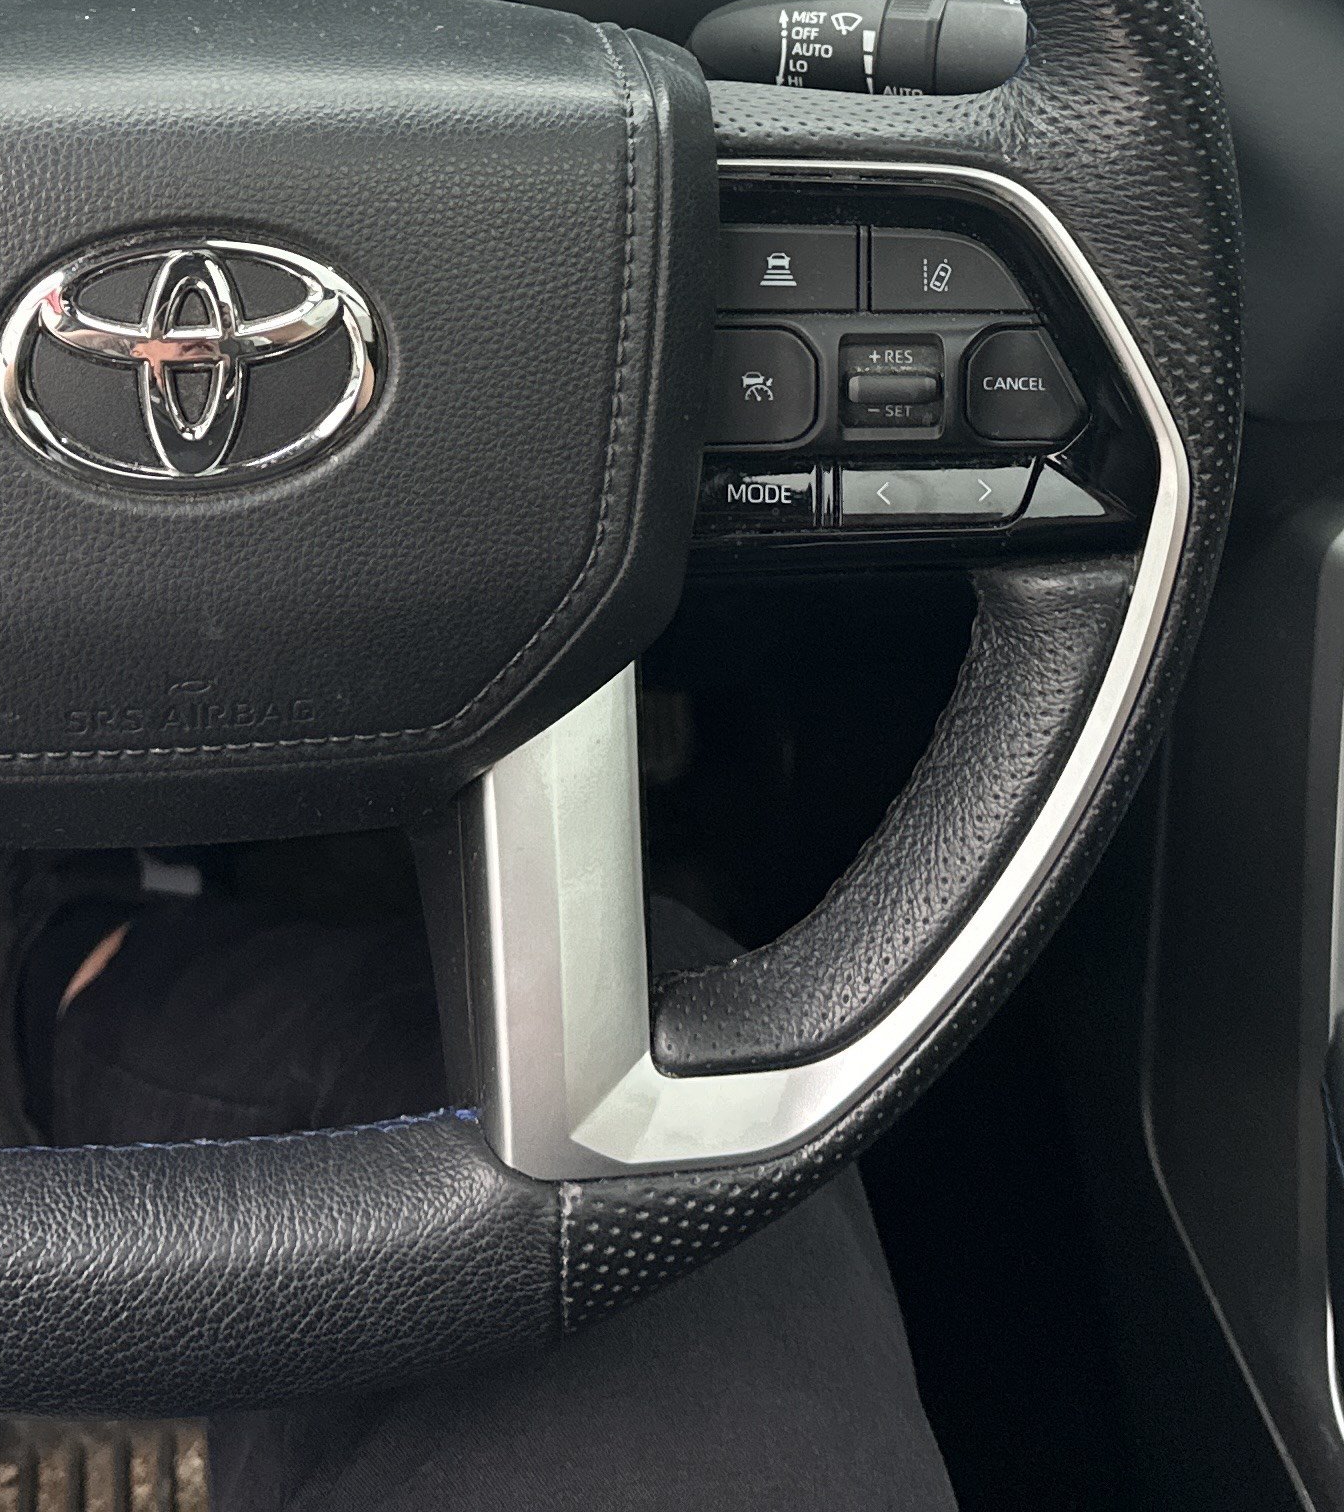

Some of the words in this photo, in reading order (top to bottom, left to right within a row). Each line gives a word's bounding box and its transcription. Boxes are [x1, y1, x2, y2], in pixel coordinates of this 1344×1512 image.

[791, 10, 827, 25] MIST
[791, 26, 819, 41] OFF
[791, 42, 833, 59] AUTO
[789, 58, 808, 73] LO
[787, 75, 804, 88] HI
[982, 376, 1047, 392] CANCEL
[727, 484, 793, 506] MODE
